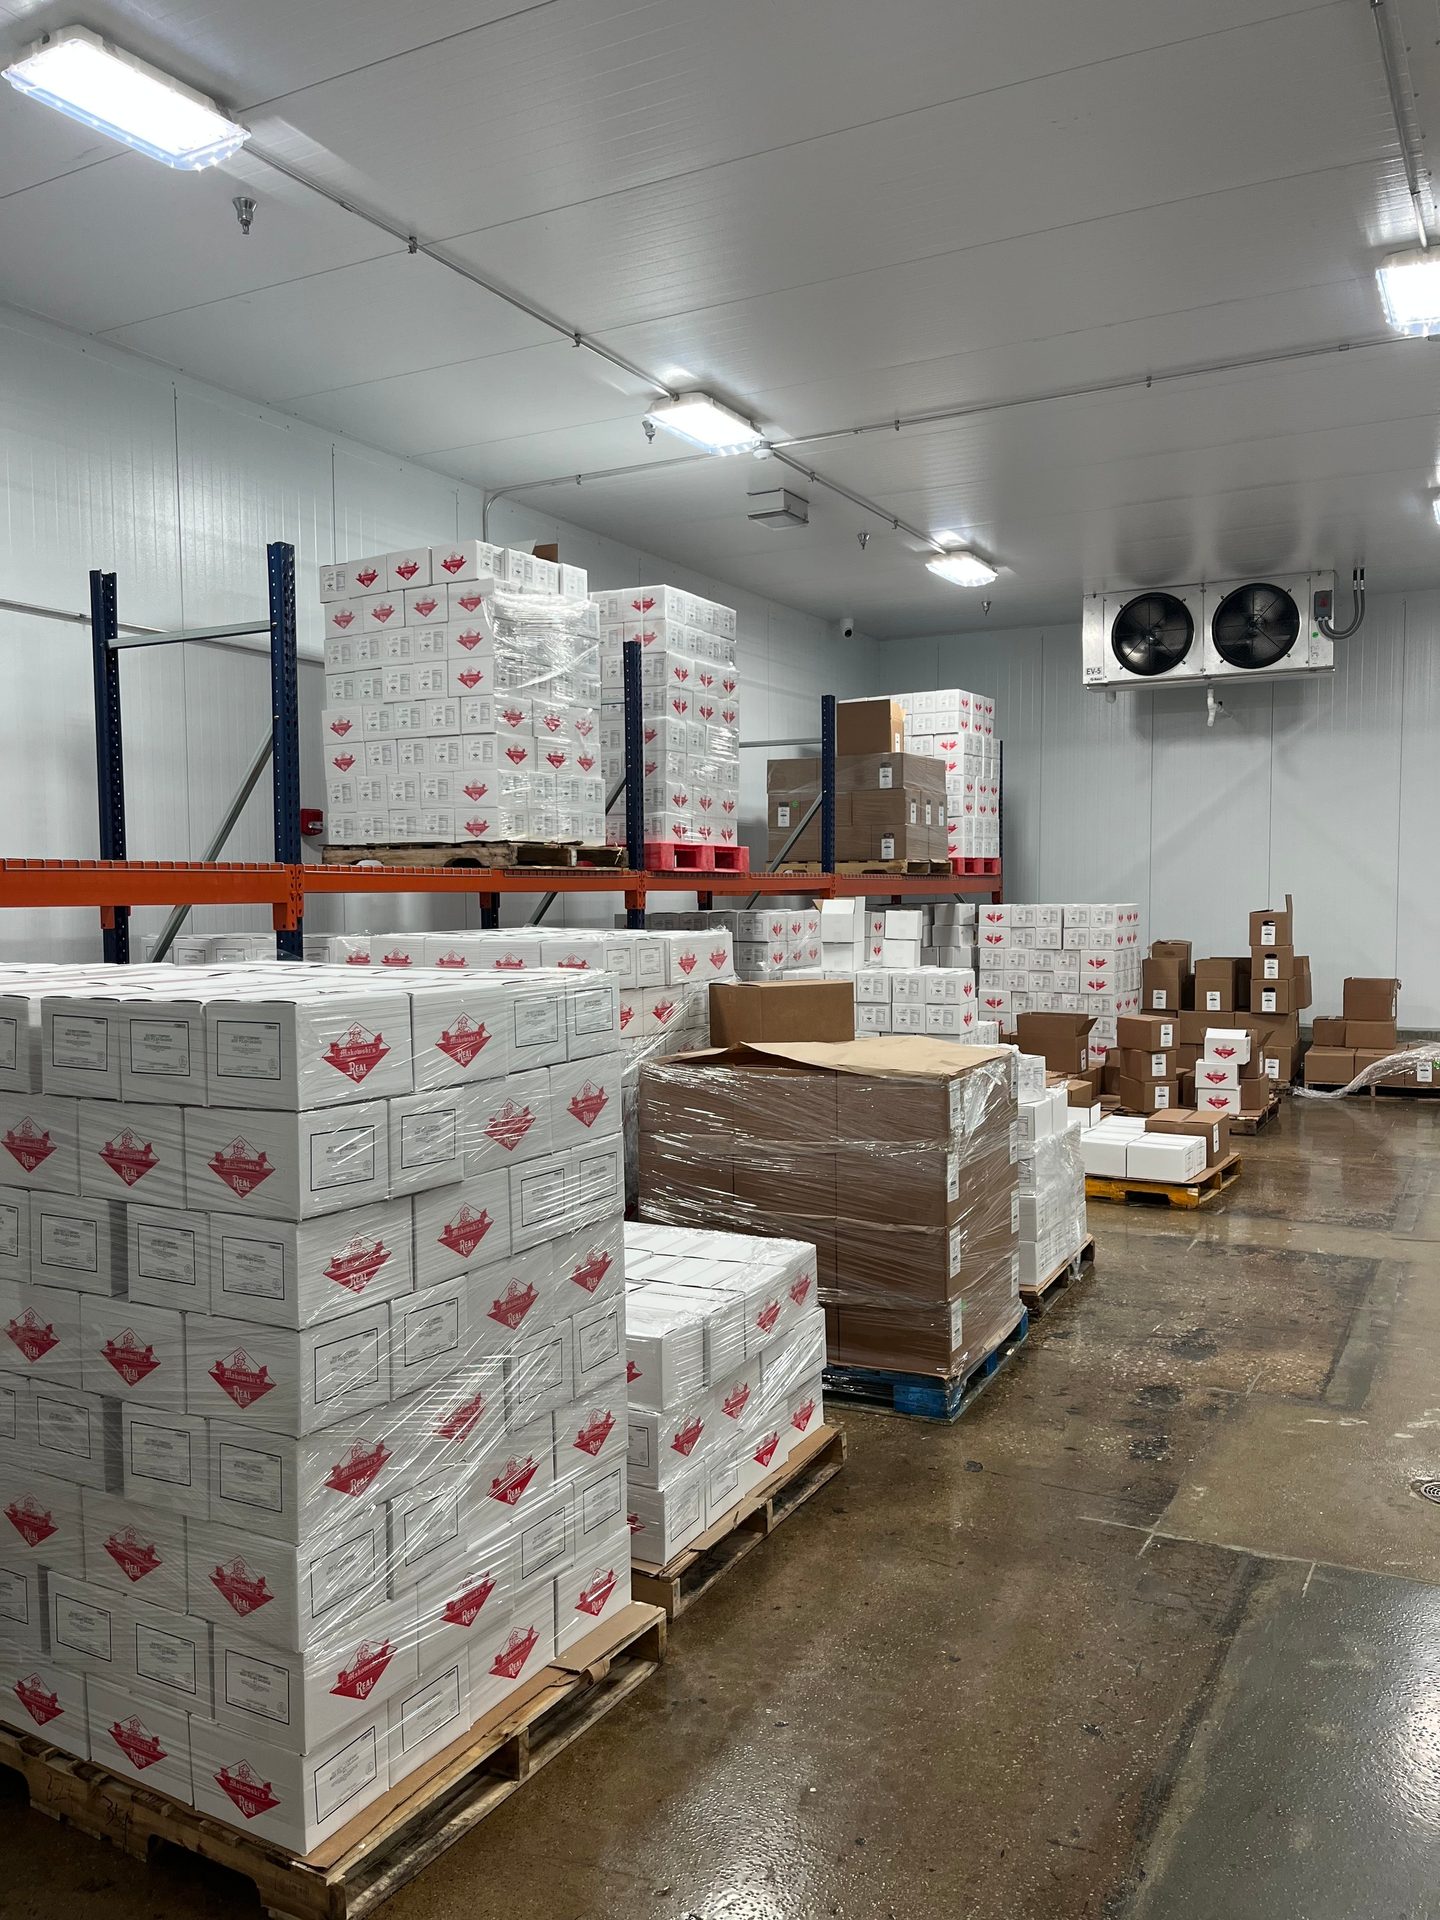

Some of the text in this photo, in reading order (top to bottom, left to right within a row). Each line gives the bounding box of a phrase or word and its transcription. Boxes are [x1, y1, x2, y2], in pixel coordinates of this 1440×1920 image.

[450, 1034, 480, 1045] Makowski's
[338, 1046, 377, 1058] Makowski's
[457, 1049, 473, 1065] REAL
[349, 1061, 368, 1077] REAL
[21, 1151, 36, 1168] REAL
[121, 1164, 137, 1181] REAL
[232, 1174, 251, 1193] REAL
[459, 1239, 475, 1254] REAL
[350, 1273, 368, 1288] REAL
[586, 1276, 599, 1290] REAL
[508, 1312, 521, 1327] REAL
[24, 1342, 39, 1358] REAL
[122, 1363, 139, 1380] REAL
[224, 1369, 261, 1383] Makowski's
[233, 1385, 251, 1403] REAL
[590, 1439, 602, 1453] REAL
[350, 1478, 369, 1496] REAL
[507, 1486, 521, 1504] REAL
[24, 1527, 38, 1543] REAL
[125, 1559, 141, 1576] REAL
[232, 1593, 250, 1612] REAL
[461, 1606, 477, 1623] REAL
[508, 1659, 523, 1676] REAL
[355, 1676, 374, 1697] REAL
[229, 1779, 265, 1799] Makowski's
[239, 1795, 256, 1814] REAL
